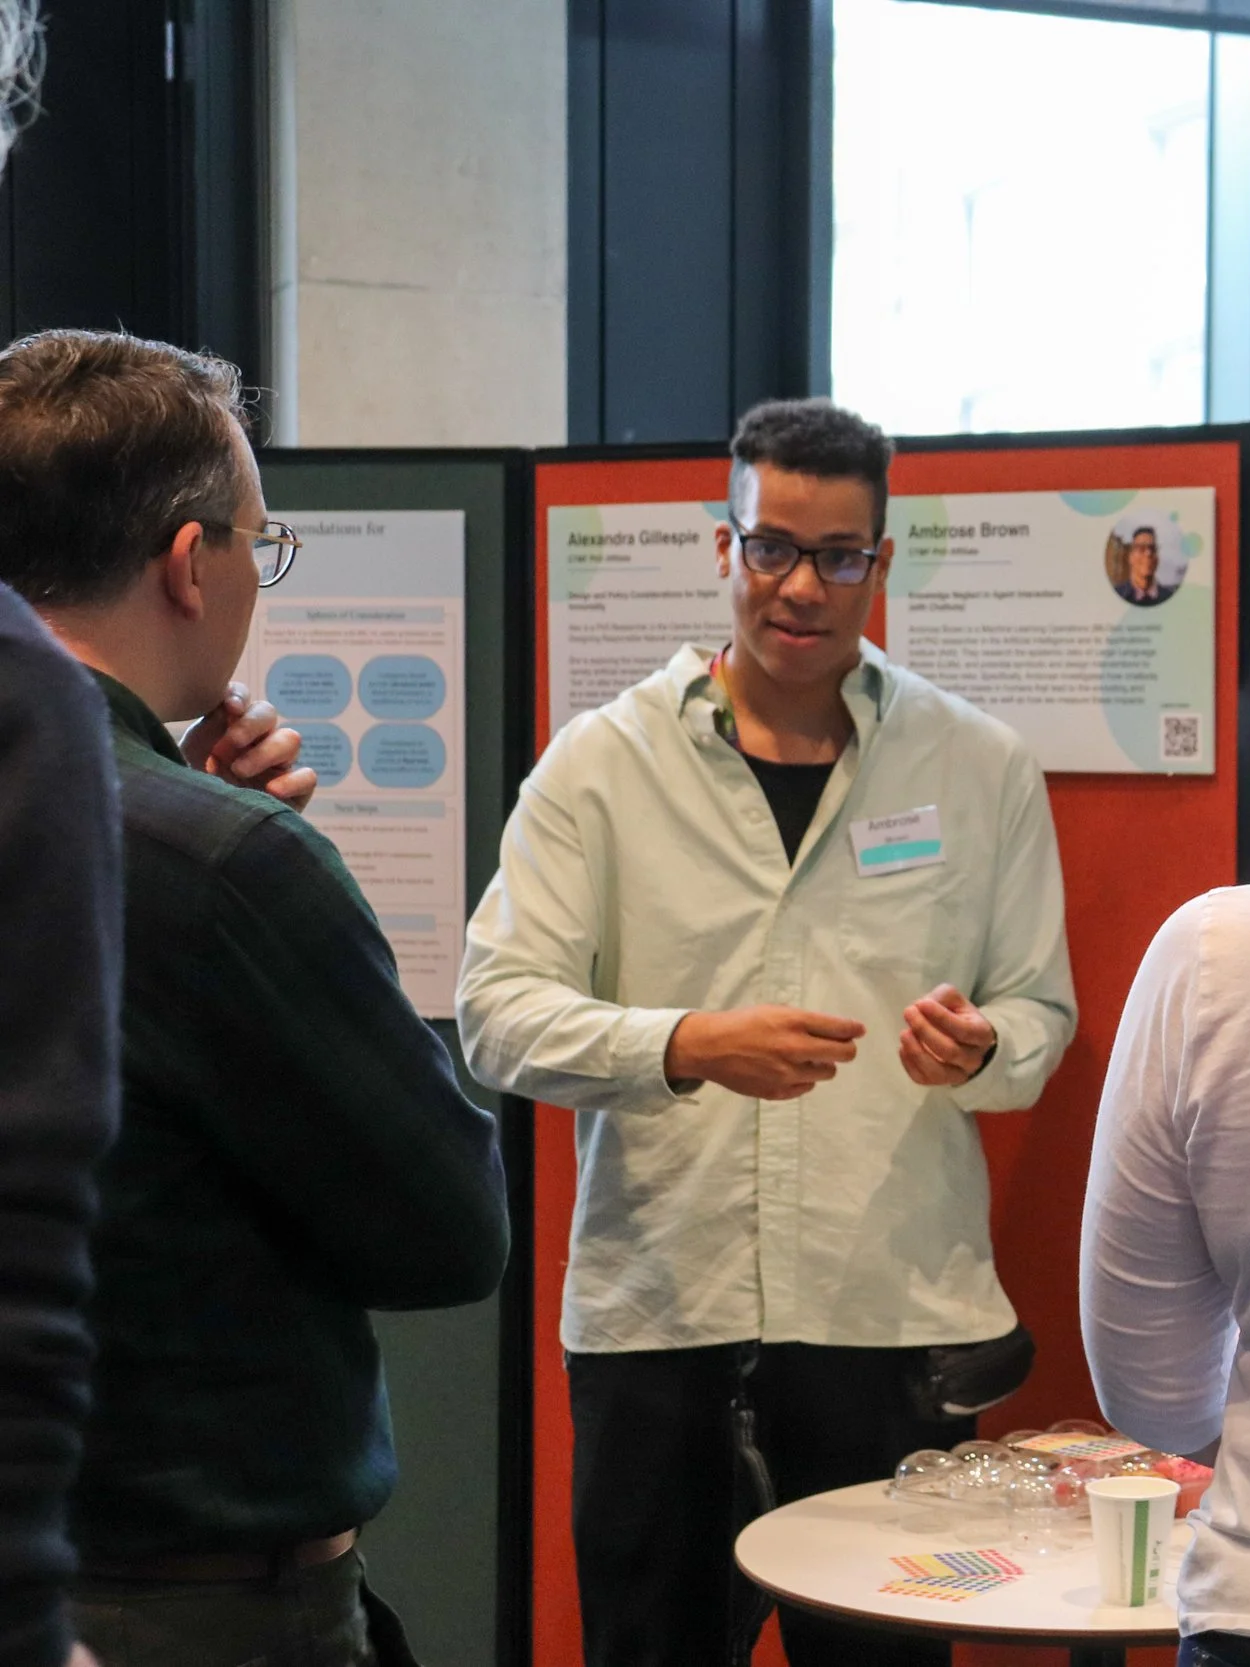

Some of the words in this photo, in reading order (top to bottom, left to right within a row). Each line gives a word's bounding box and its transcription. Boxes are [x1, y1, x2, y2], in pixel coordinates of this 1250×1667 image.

[367, 521, 386, 537] for
[908, 522, 976, 540] Ambrose
[980, 521, 1031, 540] Brown
[568, 530, 635, 547] Alexandra
[640, 529, 700, 550] Gillespie
[868, 814, 920, 832] Ambrose
